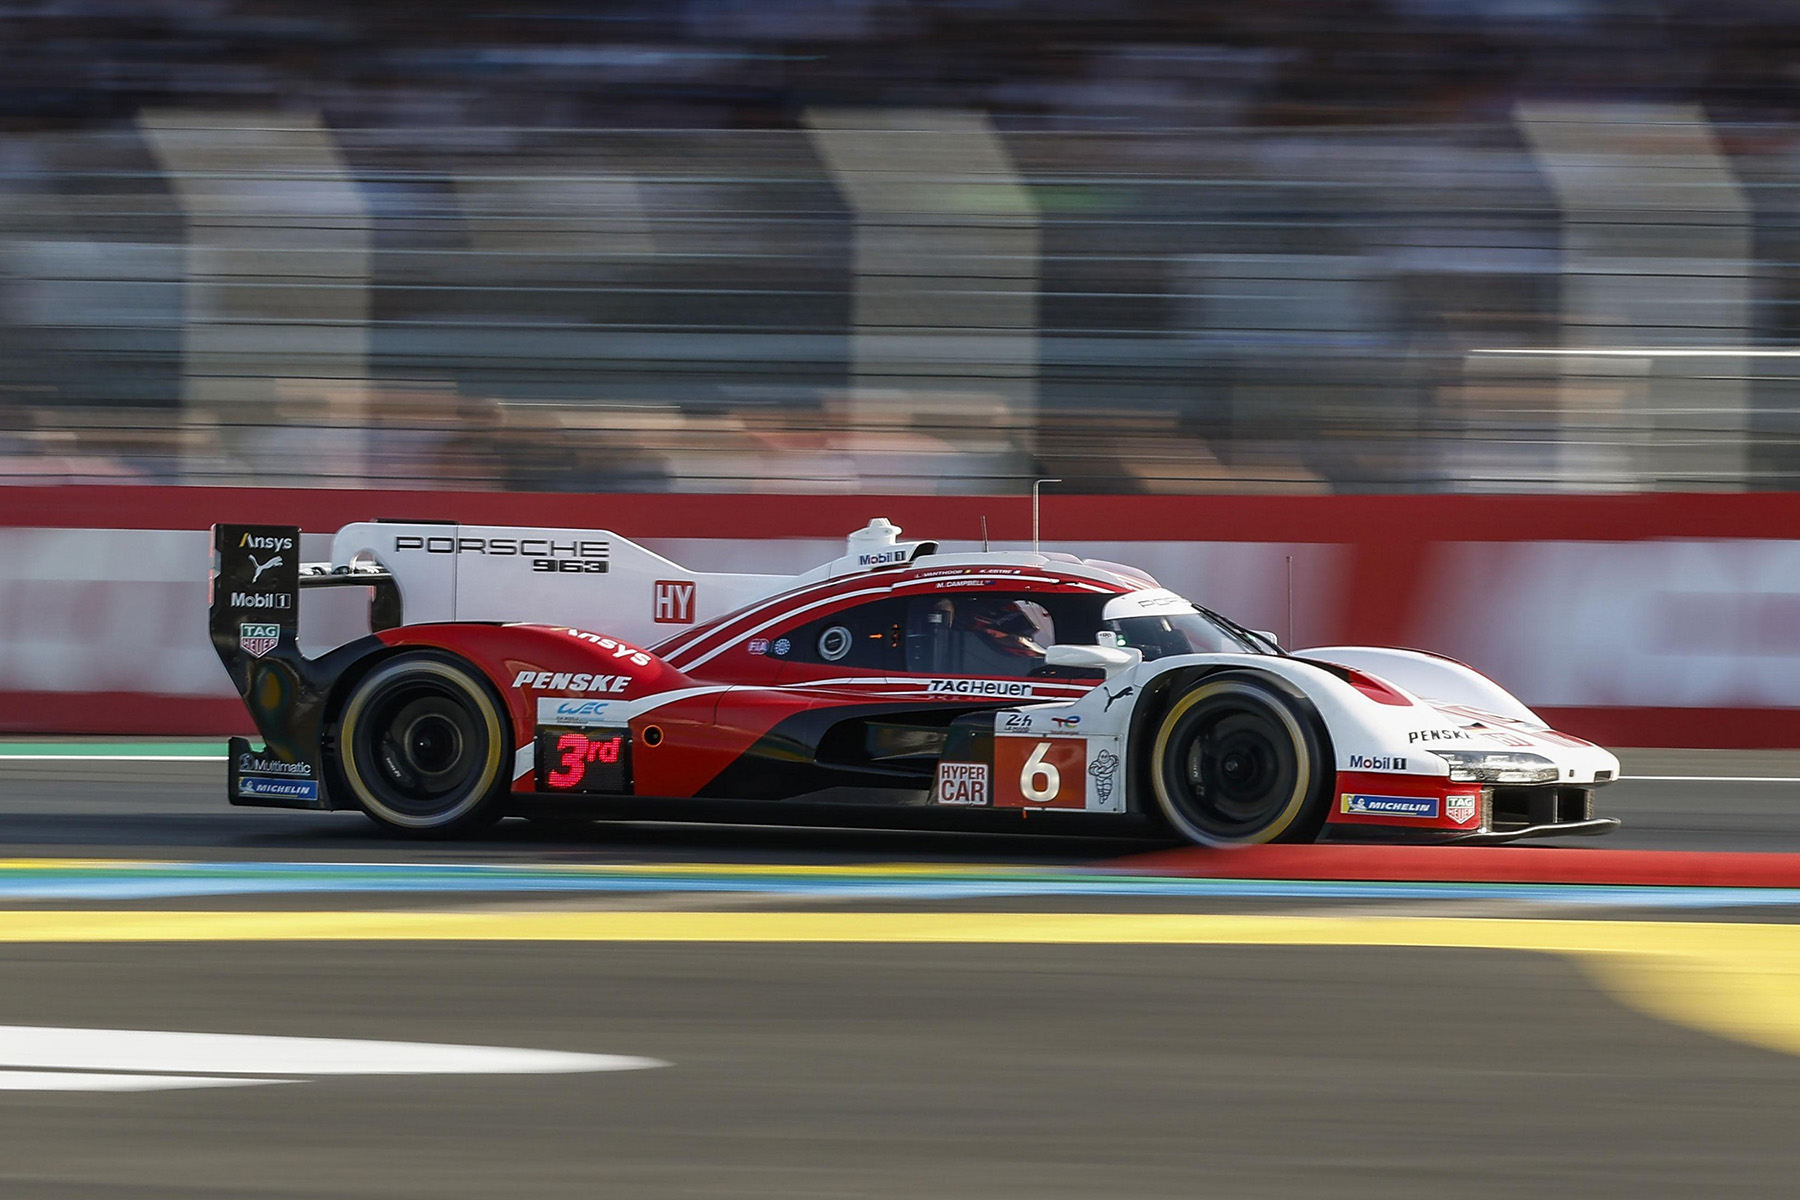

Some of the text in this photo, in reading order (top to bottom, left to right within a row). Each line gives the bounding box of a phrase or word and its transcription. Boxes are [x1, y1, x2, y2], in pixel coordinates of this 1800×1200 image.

[239, 532, 293, 553] Ansys
[396, 536, 610, 557] PORSCHE
[533, 559, 609, 573] 963
[859, 551, 904, 566] Mobil 1
[231, 592, 288, 608] Mobil 1
[656, 585, 693, 618] HY
[244, 626, 276, 637] TAG
[242, 638, 277, 656] HEUER
[551, 627, 651, 667] Ansys
[512, 671, 632, 693] PENSKE
[558, 702, 609, 715] WEC
[254, 759, 312, 773] Multimatic
[547, 733, 622, 788] 3rd
[1349, 755, 1405, 769] Mobil 1
[942, 765, 985, 779] HYPER
[1019, 742, 1061, 802] 6
[256, 784, 311, 795] MICHELIN
[941, 780, 985, 802] CAR
[1368, 801, 1431, 812] MICHELIN
[1449, 797, 1474, 807] TAG
